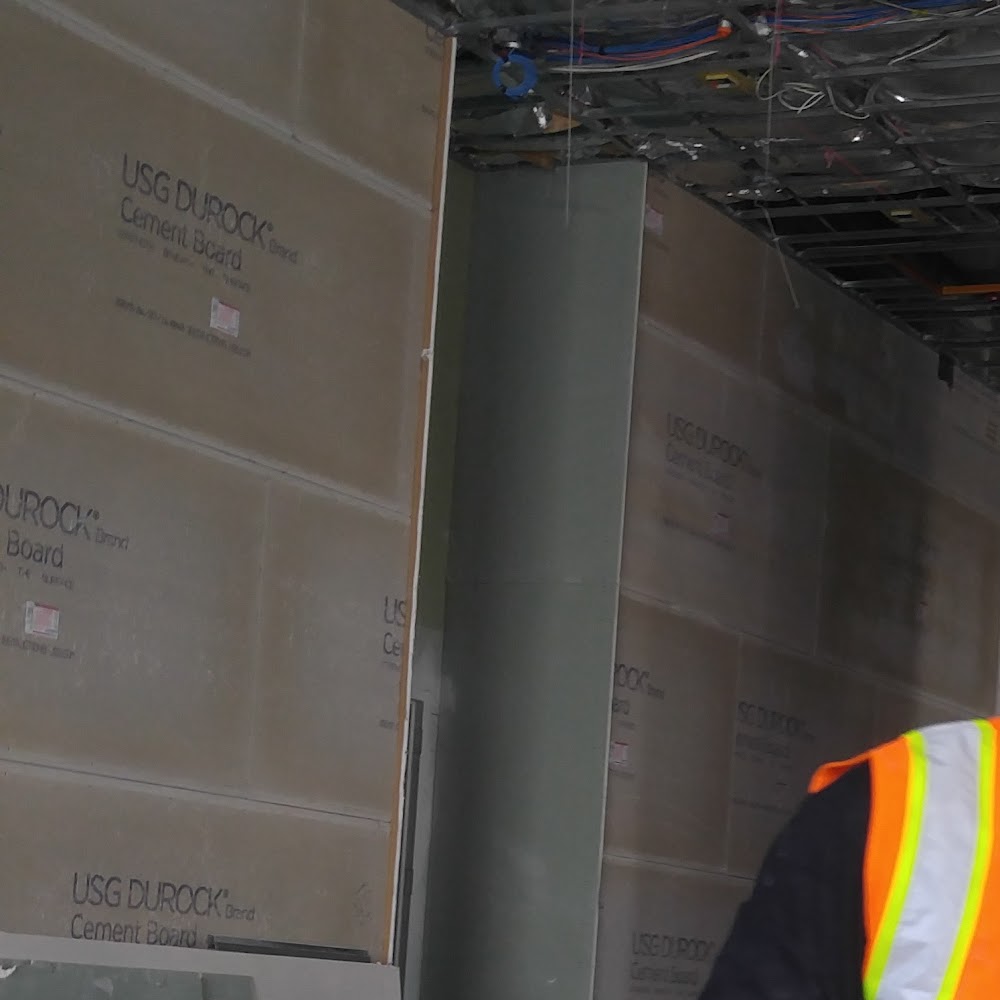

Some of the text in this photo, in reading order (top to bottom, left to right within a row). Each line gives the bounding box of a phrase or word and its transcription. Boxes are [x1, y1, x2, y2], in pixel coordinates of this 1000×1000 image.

[122, 152, 170, 204] USG
[120, 196, 188, 249] Cement
[193, 228, 242, 271] Board
[6, 529, 64, 568] Board
[72, 871, 121, 907] USG
[70, 913, 198, 948] Cement Board
